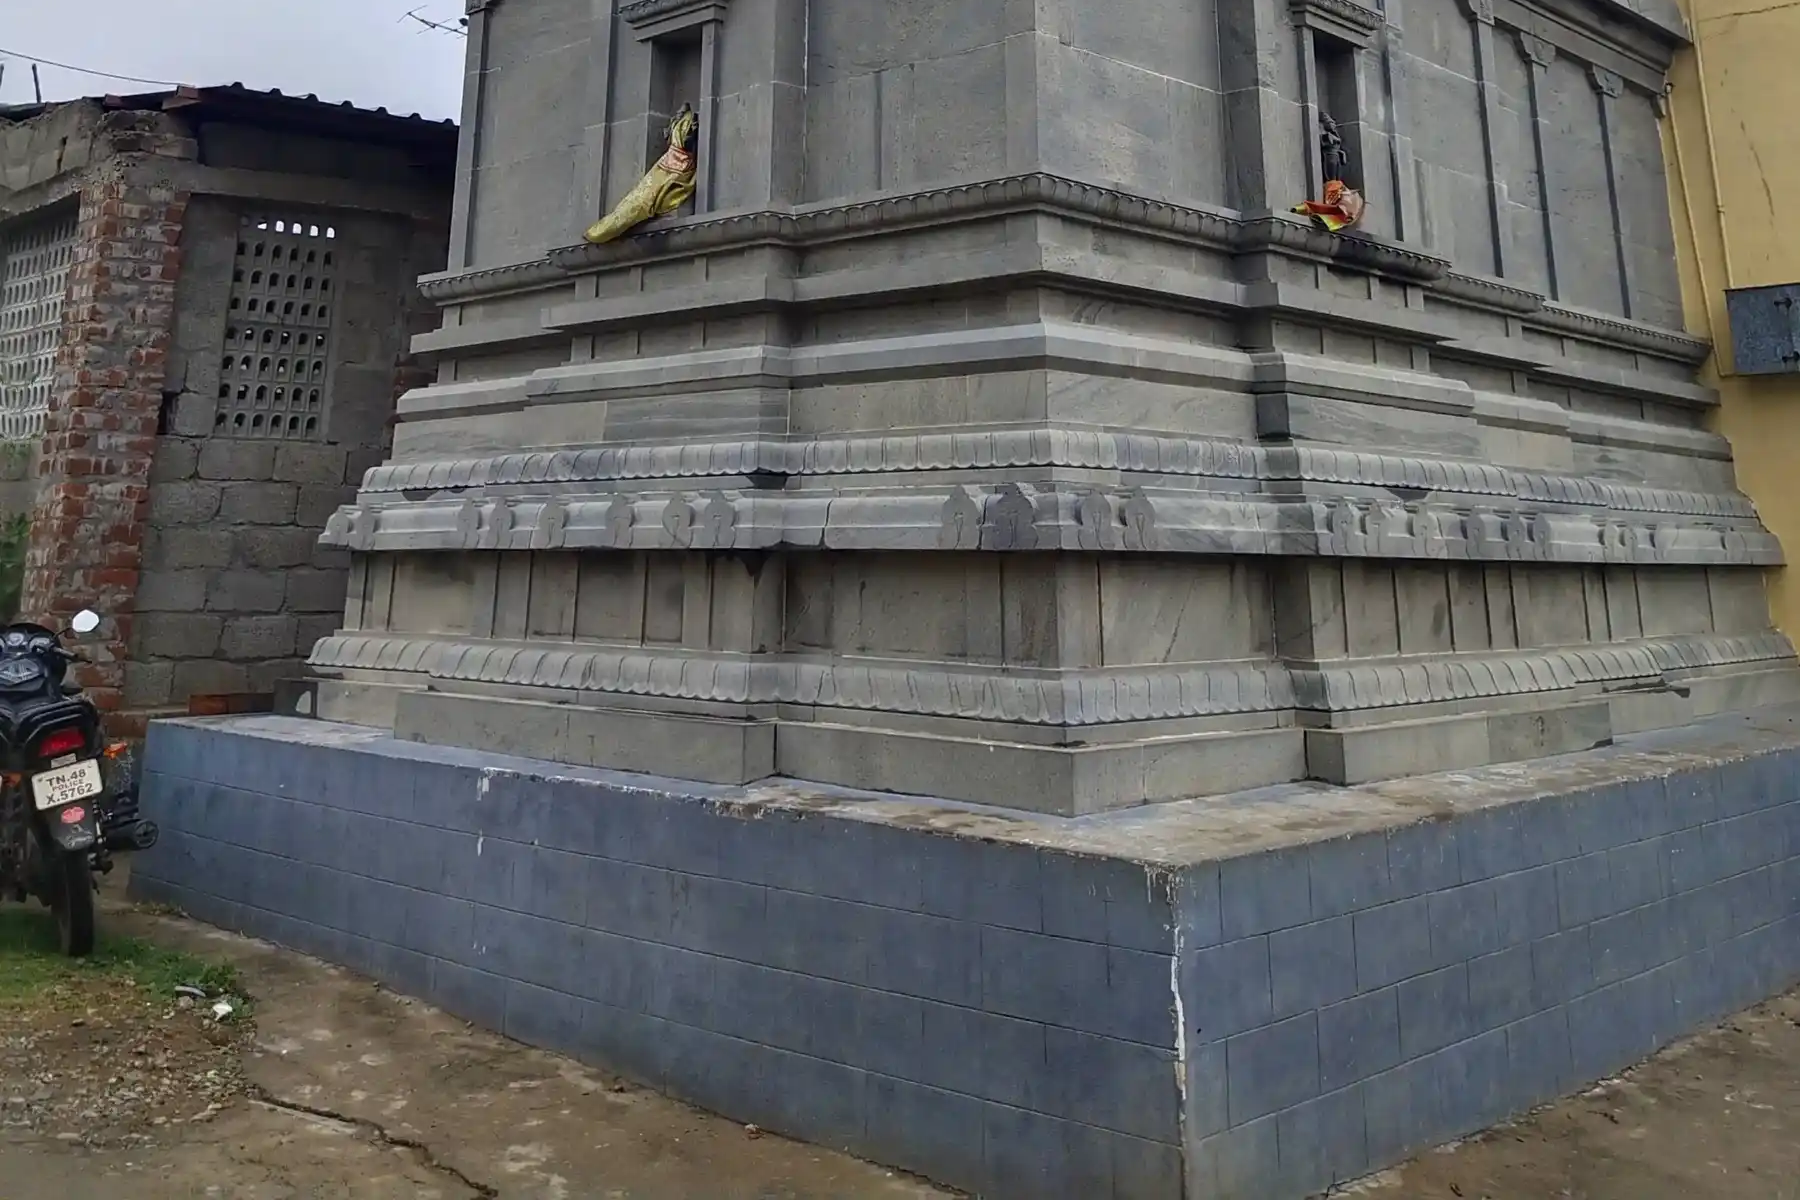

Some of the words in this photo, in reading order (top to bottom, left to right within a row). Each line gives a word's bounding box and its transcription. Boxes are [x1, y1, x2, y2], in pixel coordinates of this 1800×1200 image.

[46, 769, 86, 787] TN.48
[52, 779, 84, 791] POLICE
[46, 783, 93, 805] X.5762
